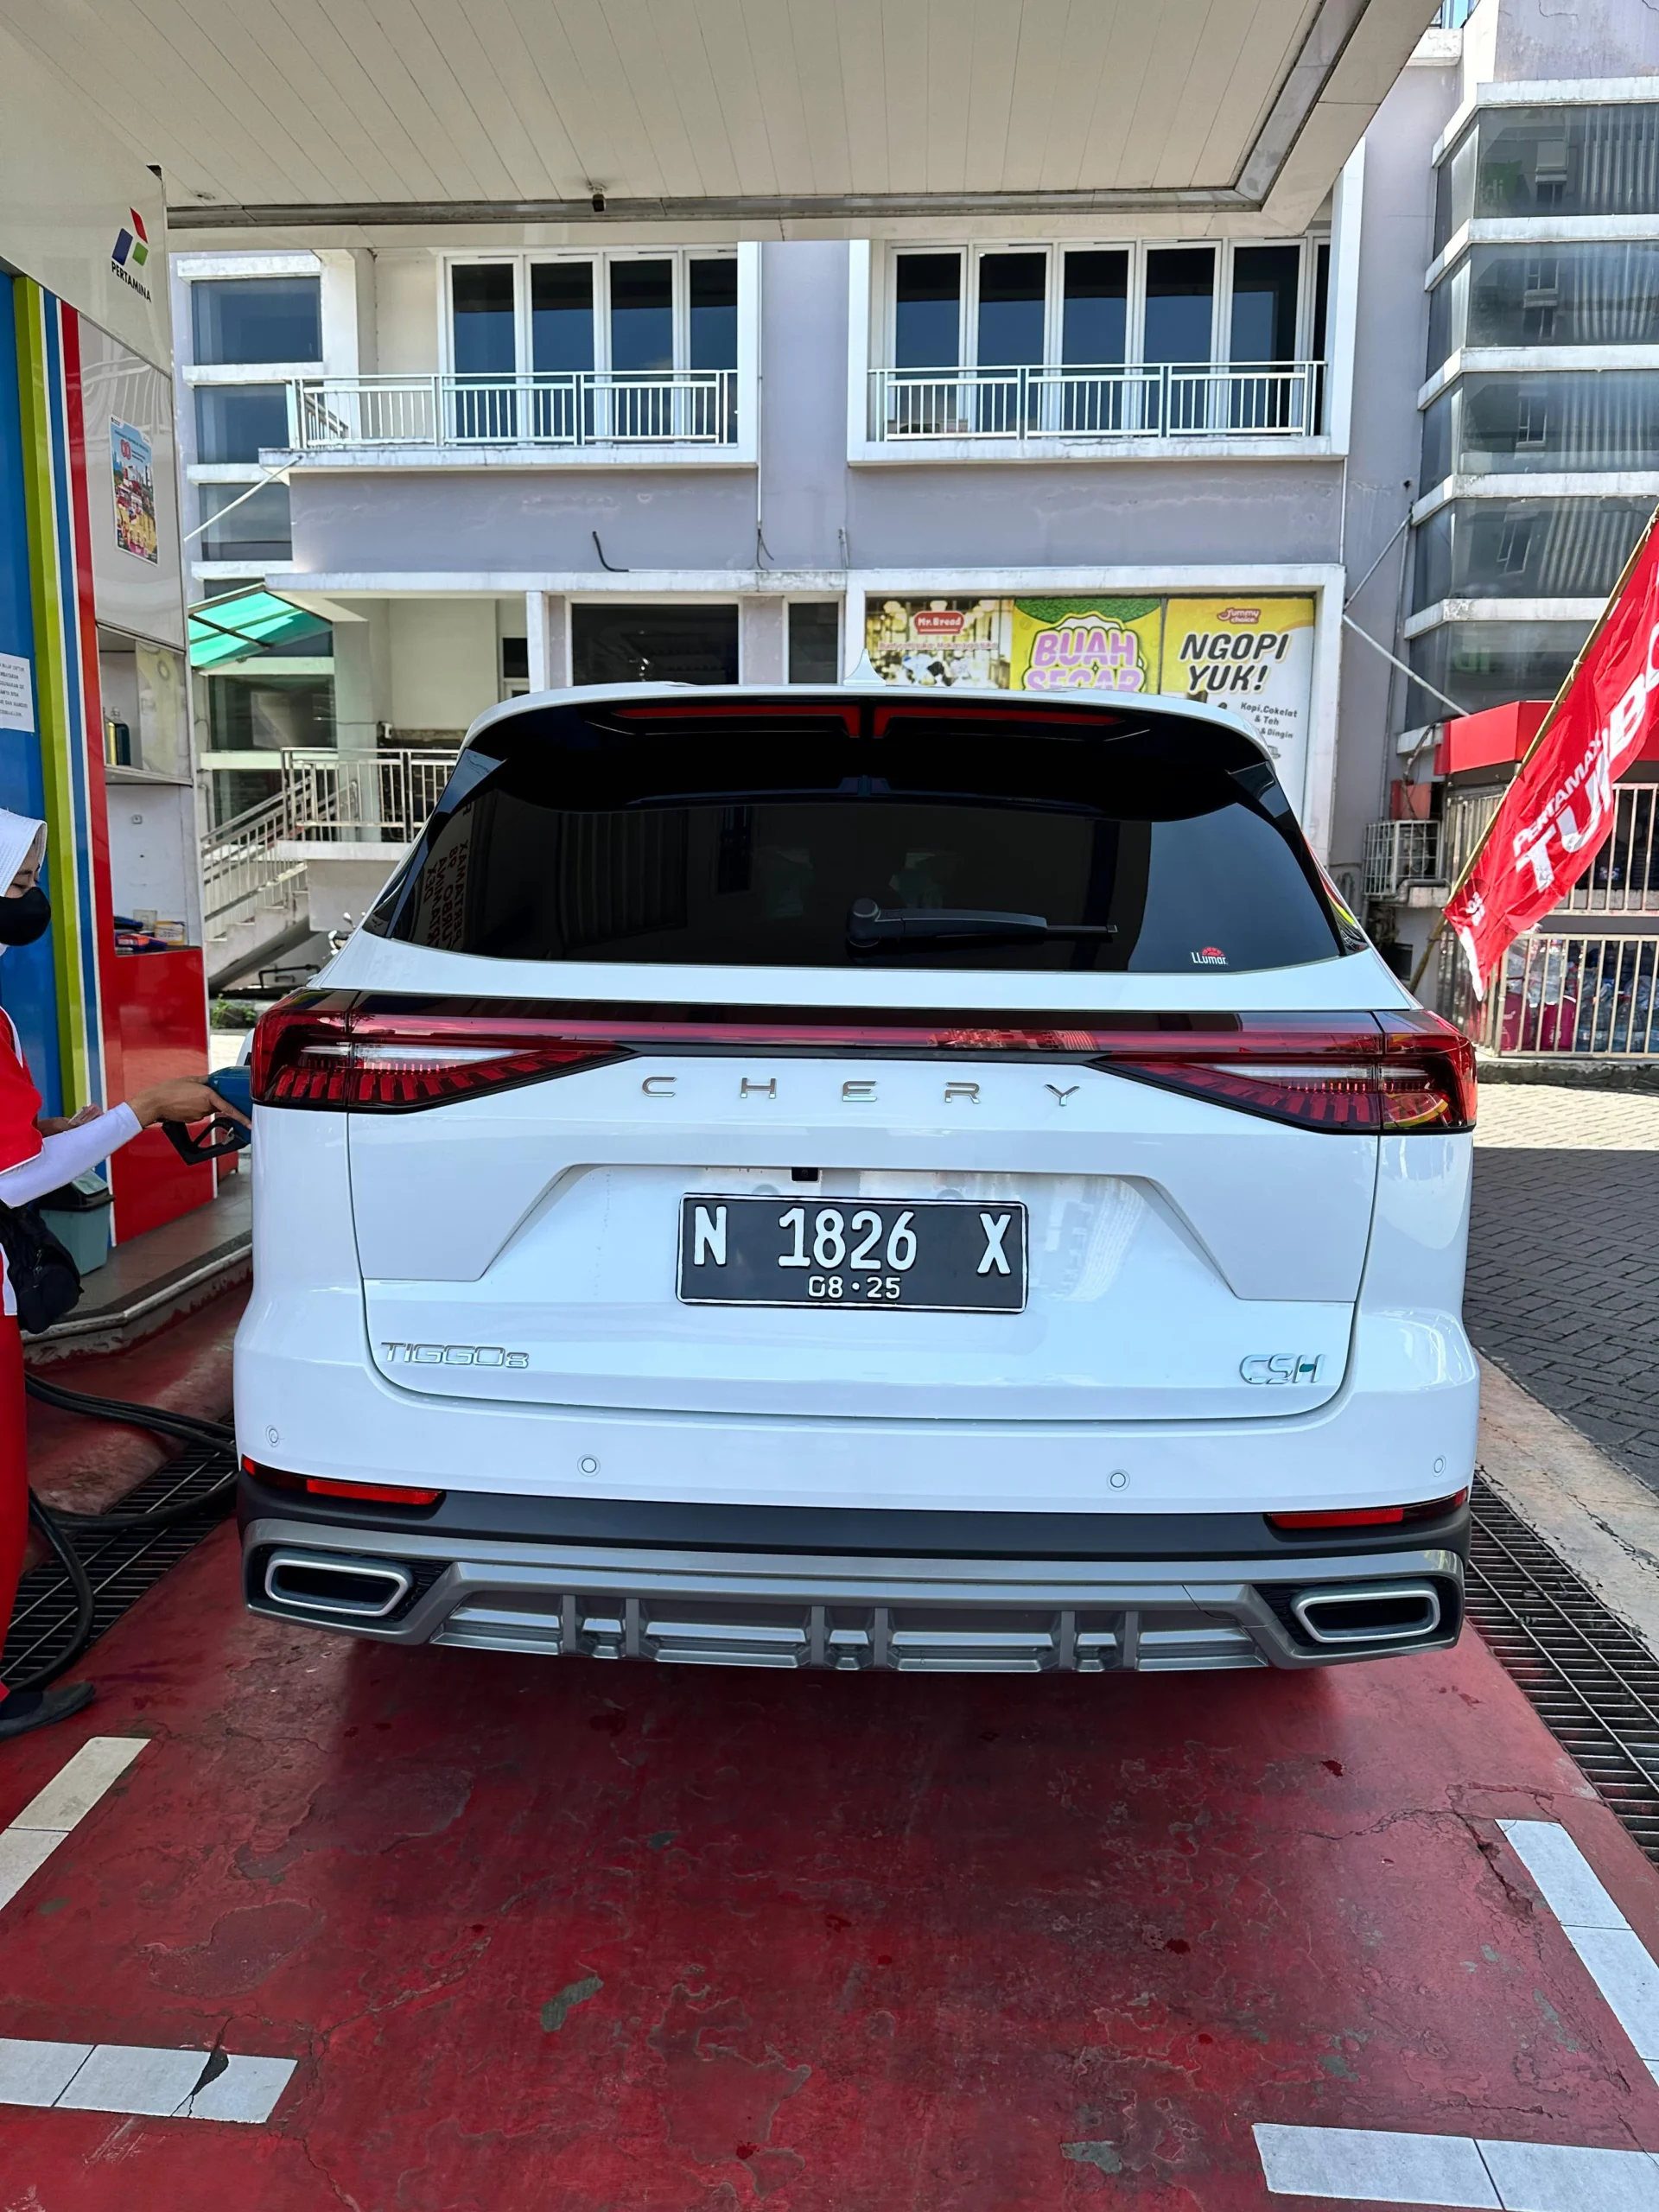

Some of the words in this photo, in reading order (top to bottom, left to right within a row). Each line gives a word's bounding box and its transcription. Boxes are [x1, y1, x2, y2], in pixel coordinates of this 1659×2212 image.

[111, 260, 152, 303] PERTAMINA
[1033, 631, 1135, 667] BUAH
[1179, 633, 1289, 661] NGOPI
[1189, 664, 1268, 691] YUK!
[1263, 715, 1280, 726] Teh
[1267, 728, 1294, 739] Dingin
[1513, 739, 1602, 858] PERTAMAX
[642, 1076, 1081, 1107] CHERY
[693, 1205, 728, 1266] N
[778, 1206, 918, 1272] 1826
[976, 1212, 1013, 1274] X
[1239, 1352, 1325, 1385] CSH
